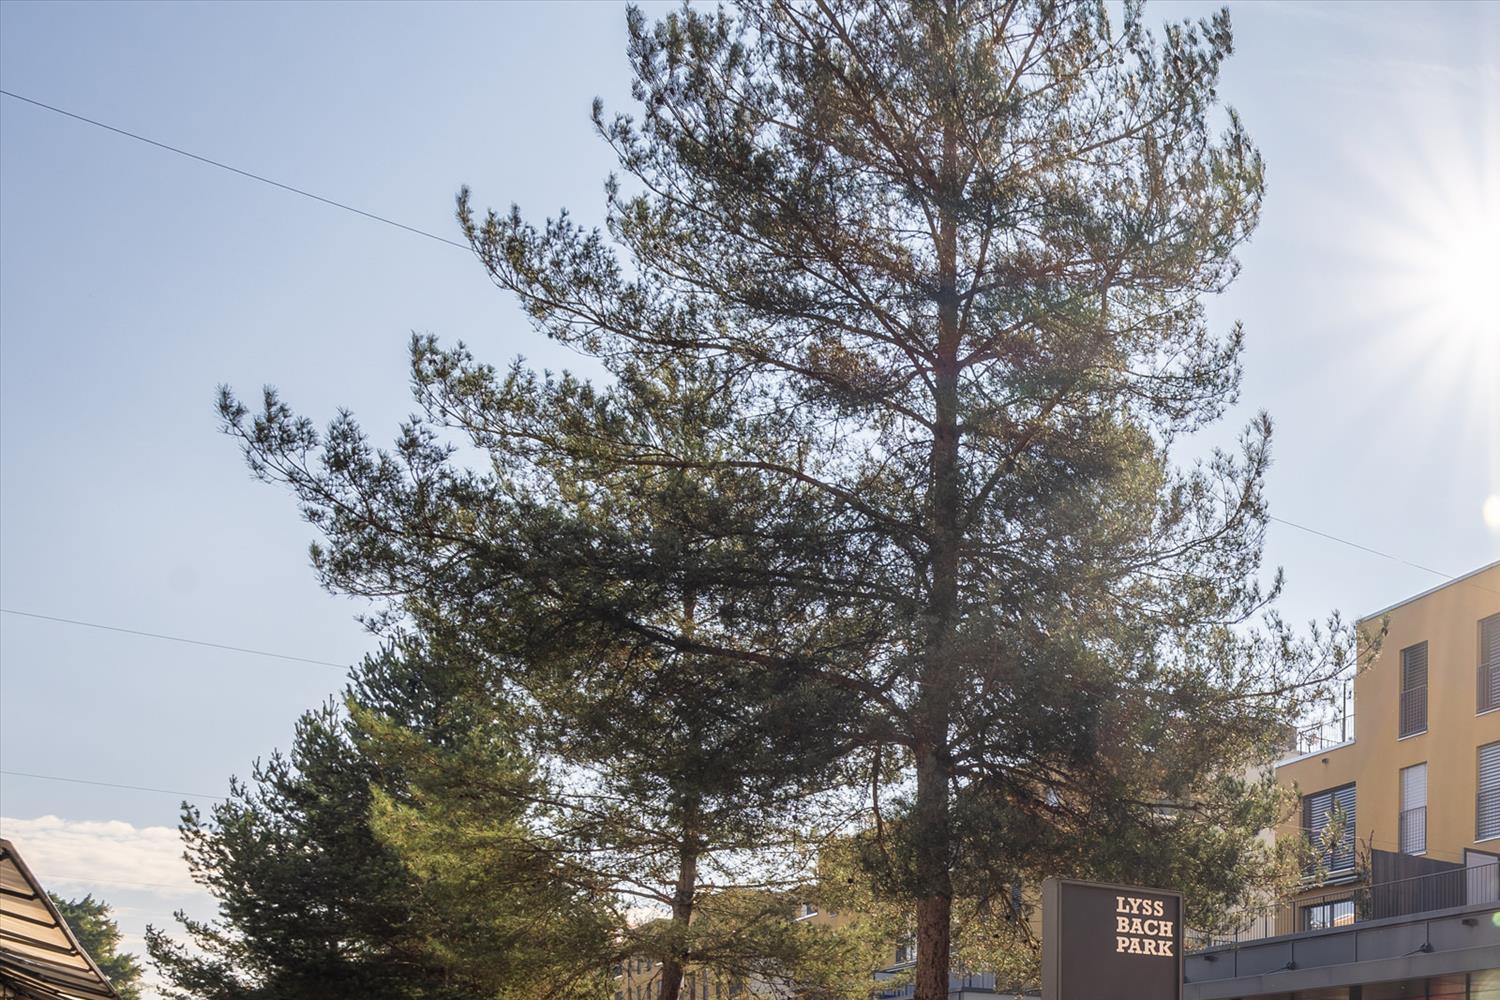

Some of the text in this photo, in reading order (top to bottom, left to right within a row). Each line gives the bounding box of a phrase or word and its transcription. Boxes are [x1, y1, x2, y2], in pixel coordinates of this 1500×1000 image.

[1116, 896, 1164, 917] LYSS
[1116, 916, 1173, 938] BACH
[1116, 936, 1173, 957] PARK
